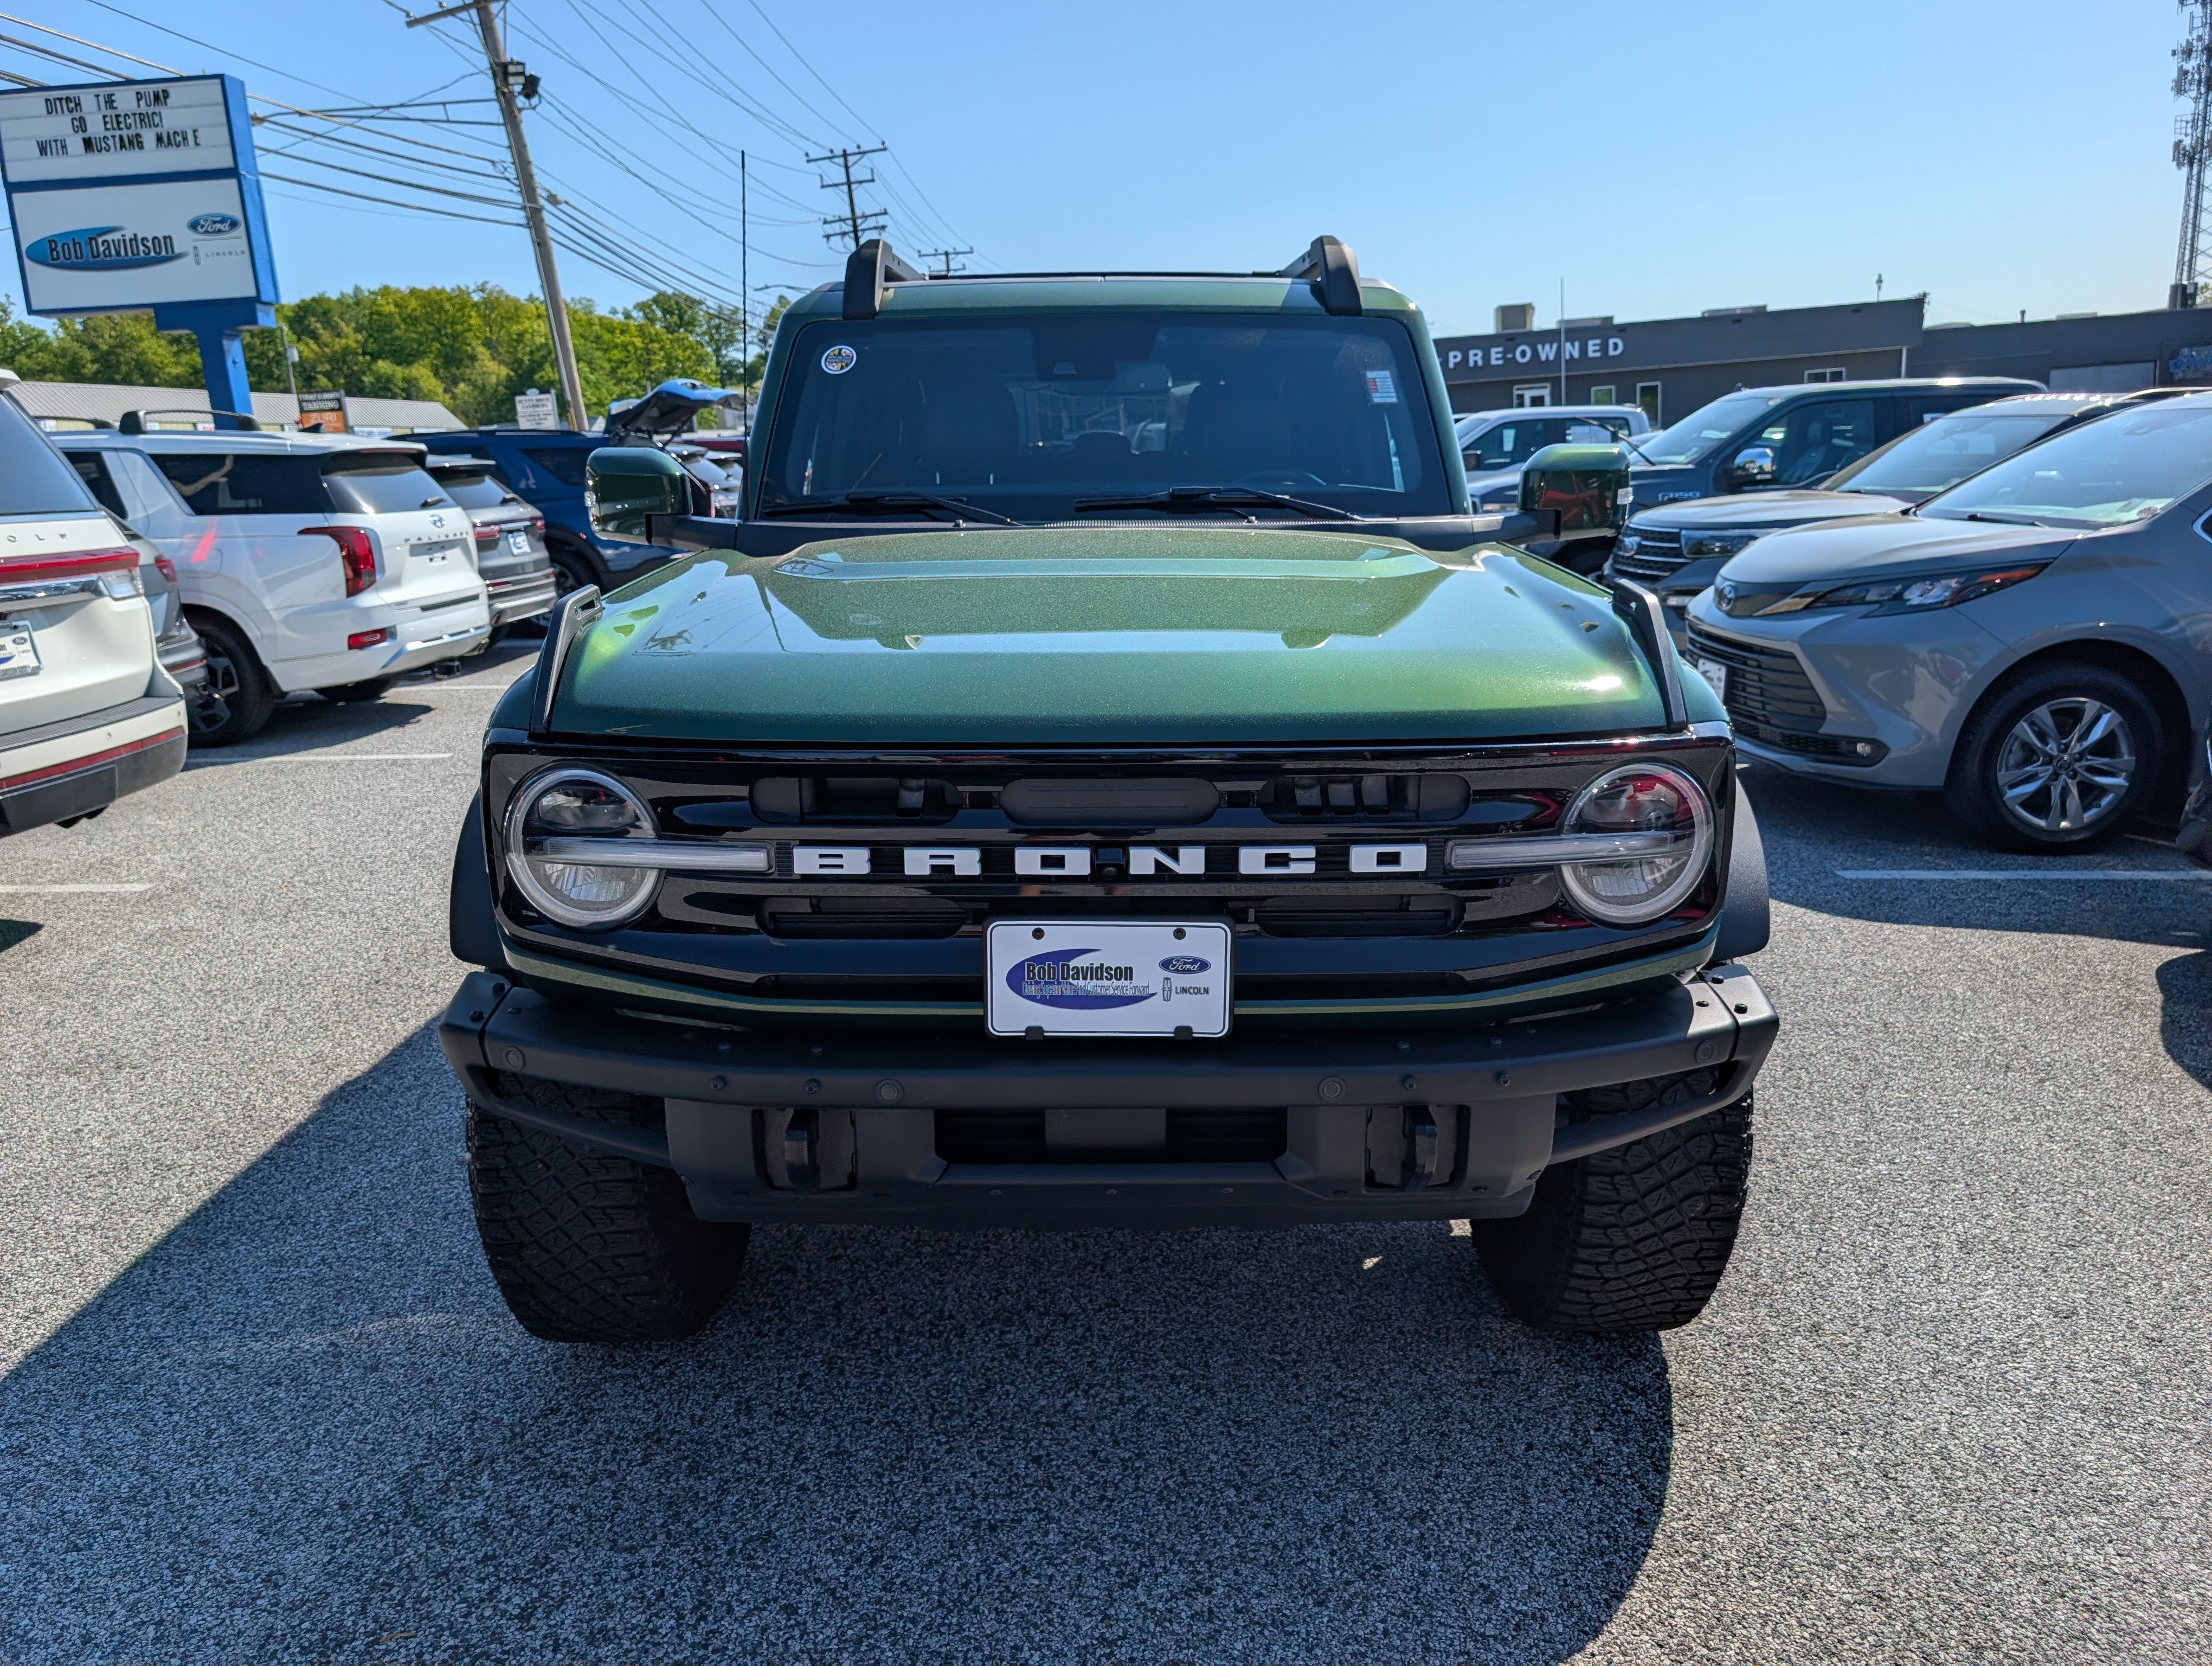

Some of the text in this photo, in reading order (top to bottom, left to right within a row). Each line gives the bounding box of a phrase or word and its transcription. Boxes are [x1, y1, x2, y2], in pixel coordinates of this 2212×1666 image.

[44, 89, 170, 115] DITCH THE PUMP
[71, 111, 164, 133] GO ELECTRIC!
[36, 128, 201, 156] WITH MUSTANG MACH E
[197, 217, 231, 233] Ford
[48, 233, 175, 261] Bob Davidson
[1448, 337, 1624, 369] PRE-OWNED
[793, 843, 1427, 875] BRONCO
[1026, 963, 1133, 981] Bob Davidson
[1169, 958, 1201, 971] Ford
[1023, 981, 1040, 999] Driving
[1041, 981, 1061, 999] Superior
[1087, 981, 1110, 995] Customer
[1111, 981, 1128, 995] Service
[1129, 981, 1149, 996] Forward
[1175, 986, 1210, 995] LINCOLN
